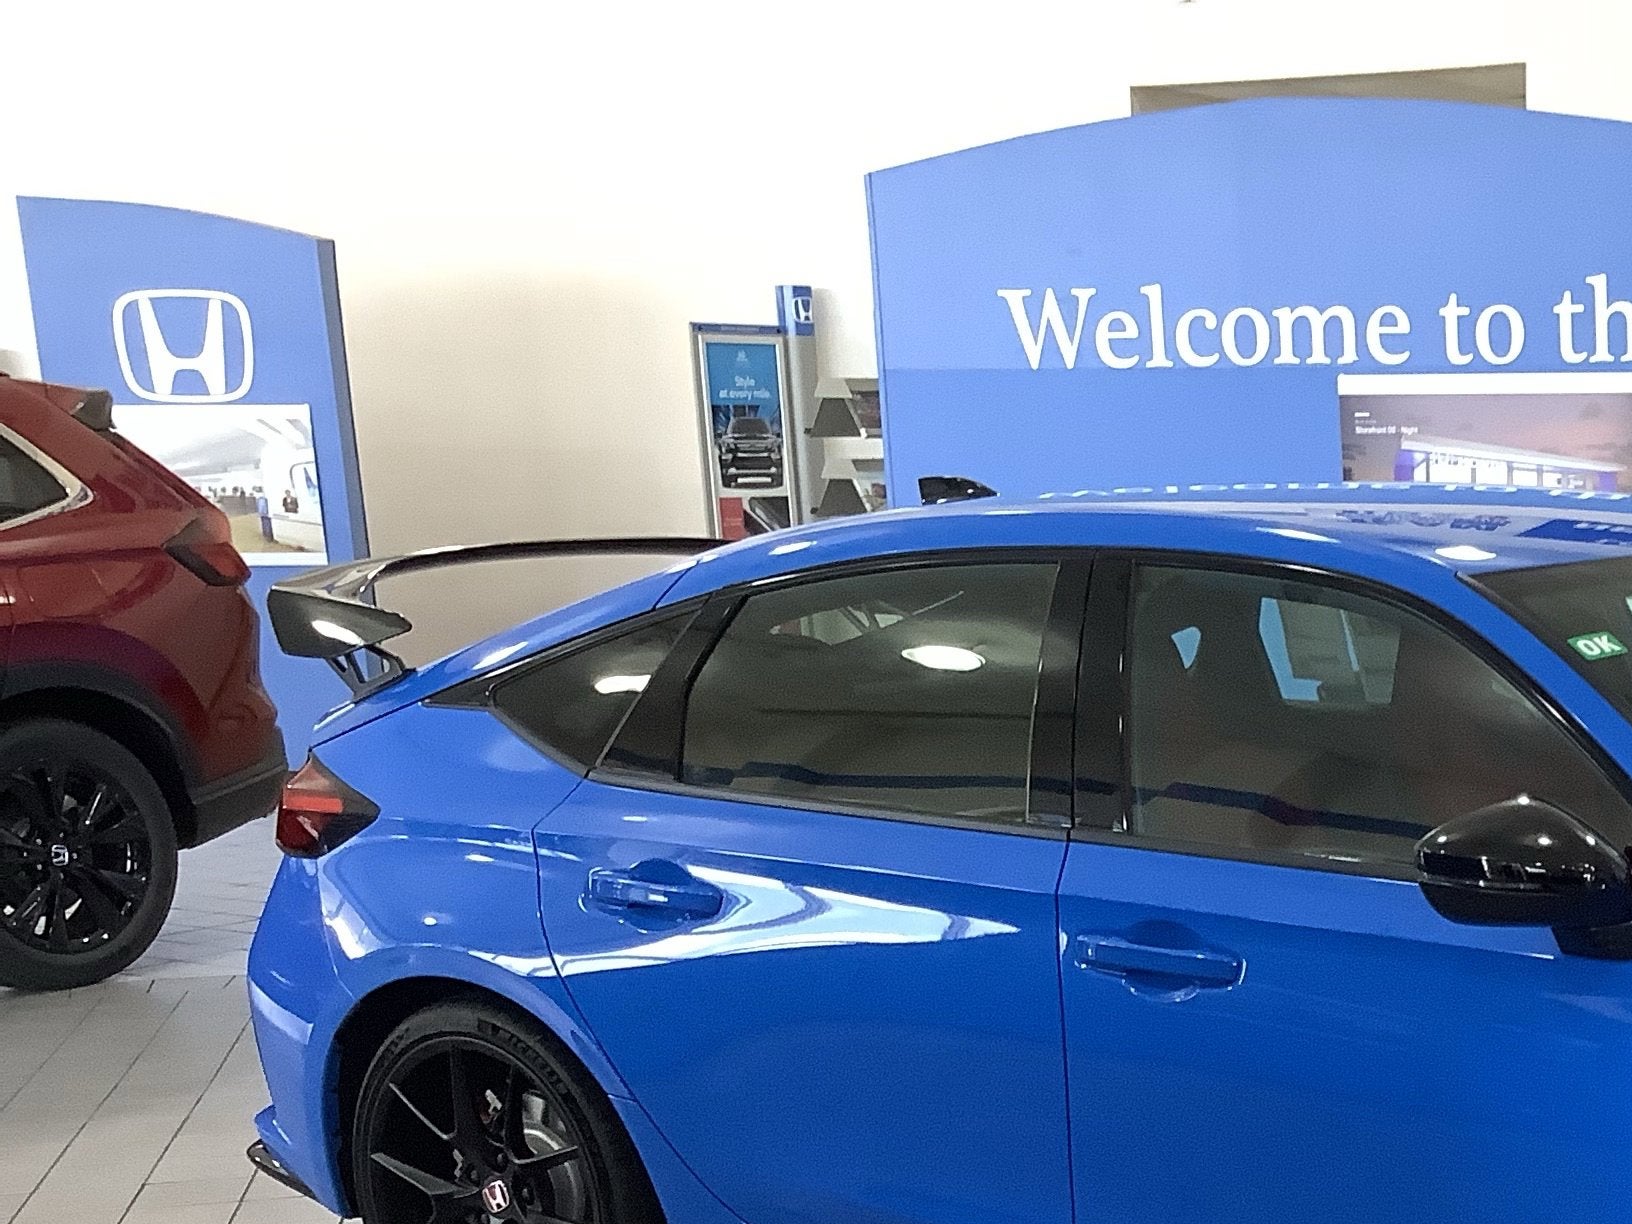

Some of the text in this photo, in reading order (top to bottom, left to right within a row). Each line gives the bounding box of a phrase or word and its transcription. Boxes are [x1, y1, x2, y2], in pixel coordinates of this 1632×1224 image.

[996, 282, 1411, 370] Welcome
[1438, 293, 1525, 366] to
[1576, 634, 1622, 656] OK
